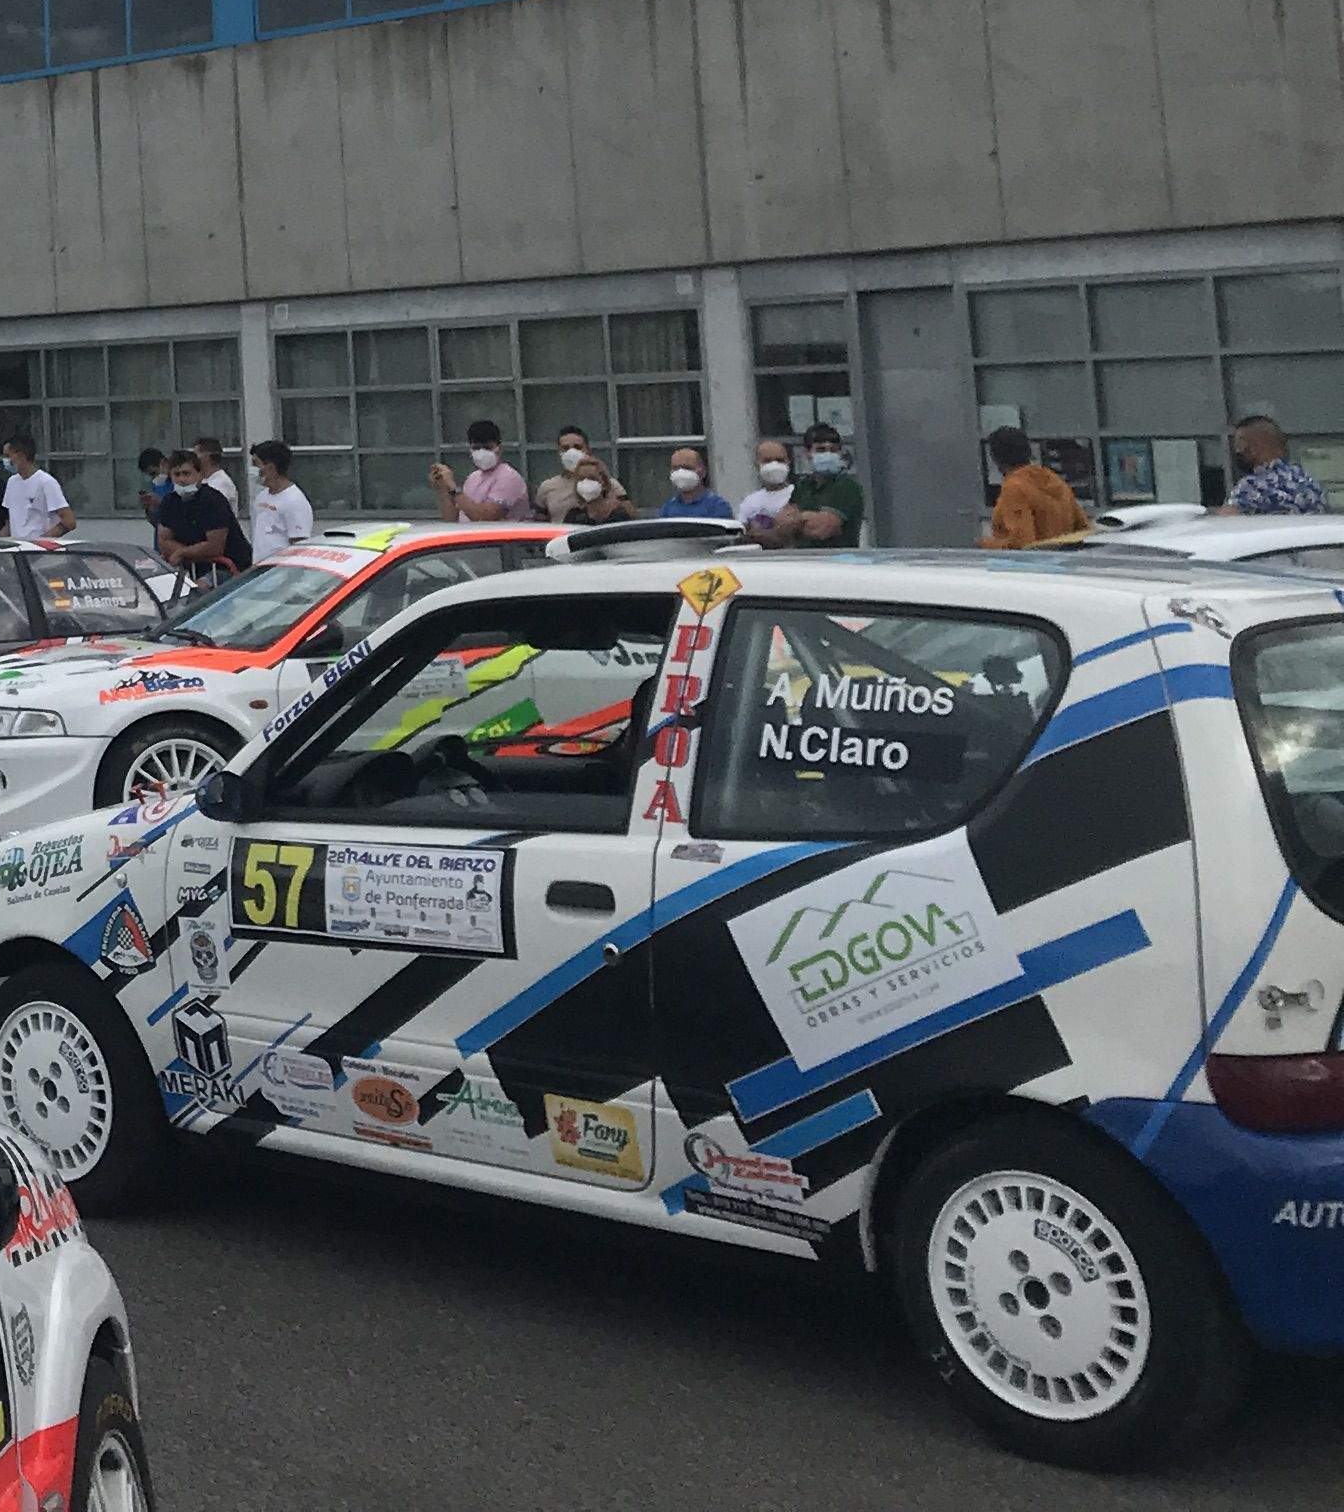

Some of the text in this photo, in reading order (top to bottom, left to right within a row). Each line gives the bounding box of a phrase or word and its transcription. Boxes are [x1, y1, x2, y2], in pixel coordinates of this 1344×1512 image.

[262, 639, 374, 744] Forza BENI
[364, 869, 464, 890] Ayuntamiento
[405, 854, 433, 870] DEL
[438, 856, 497, 874] BIERZO
[243, 843, 316, 928] 57
[364, 891, 464, 912] de Ponferrada
[806, 995, 862, 1028] OBRAS
[868, 988, 879, 999] Y
[886, 940, 987, 992] SERVICIOS
[160, 1070, 247, 1110] MERAKI
[1271, 1199, 1344, 1229] AUT
